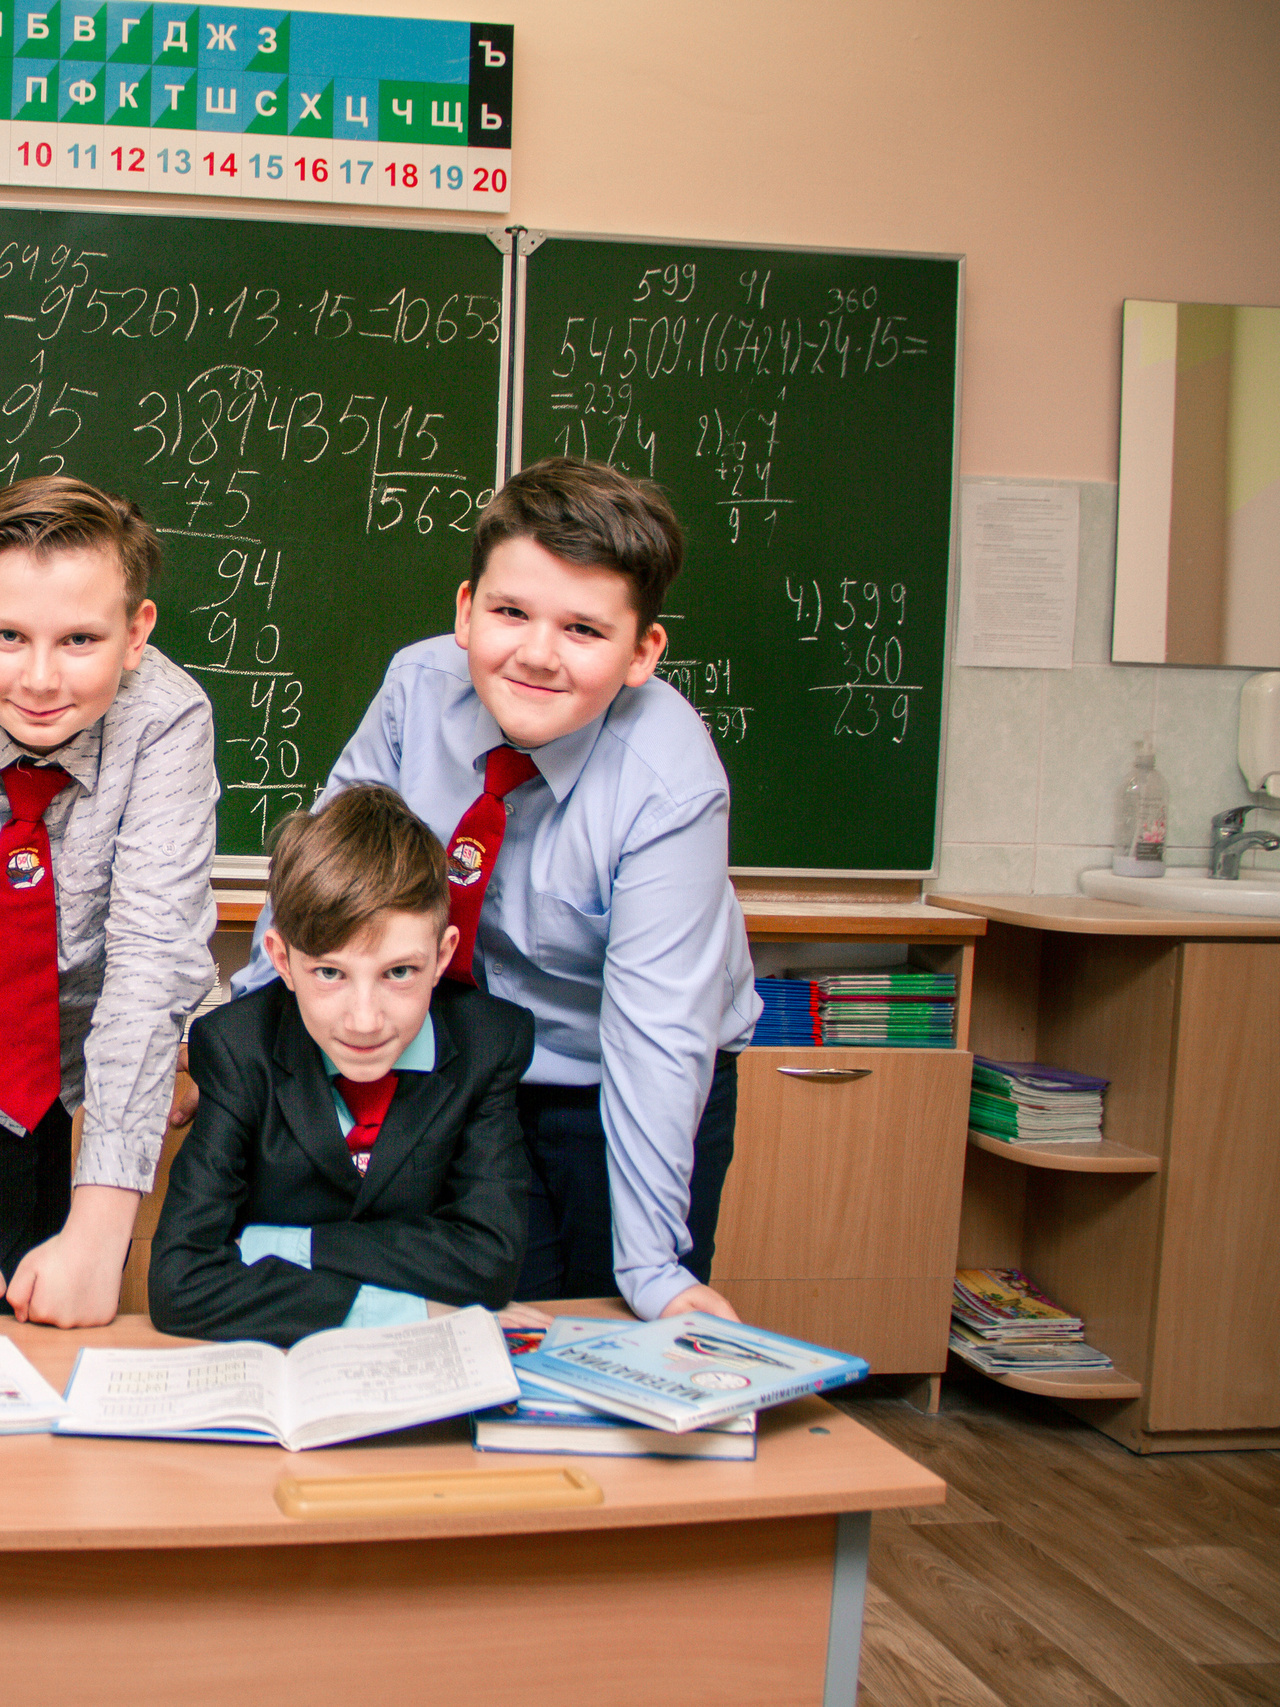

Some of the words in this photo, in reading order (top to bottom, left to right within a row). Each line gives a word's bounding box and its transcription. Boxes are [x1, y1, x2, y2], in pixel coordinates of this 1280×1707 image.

[26, 13, 50, 40] Б
[73, 15, 96, 42] В
[122, 17, 140, 44] Г
[163, 21, 188, 53] Д
[206, 23, 237, 51] Ж
[257, 26, 277, 54] З
[478, 40, 506, 67] Ъ
[26, 77, 48, 103] П
[68, 80, 97, 106] Ф
[119, 82, 139, 108] К
[164, 84, 185, 110] Т
[205, 87, 237, 114] Ш
[254, 90, 278, 117] С
[299, 93, 322, 119] Х
[345, 96, 368, 127] Ц
[391, 98, 413, 125] Ч
[431, 101, 463, 133] Щ
[481, 104, 503, 130] Ь
[17, 142, 53, 167] 10
[67, 144, 97, 170] 11
[110, 147, 146, 173] 12
[156, 148, 192, 175] 13
[202, 151, 238, 178] 14
[248, 153, 284, 180] 15
[293, 157, 329, 183] 16
[339, 159, 374, 186] 17
[384, 162, 419, 188] 18
[428, 164, 464, 191] 19
[473, 167, 508, 194] 20
[633, 263, 696, 302] 599
[827, 286, 877, 314] 360
[393, 405, 444, 461] 15
[732, 462, 771, 501] 24
[834, 577, 907, 630] 599
[208, 611, 280, 668] 90
[251, 678, 303, 735] 43
[834, 685, 910, 744] 239
